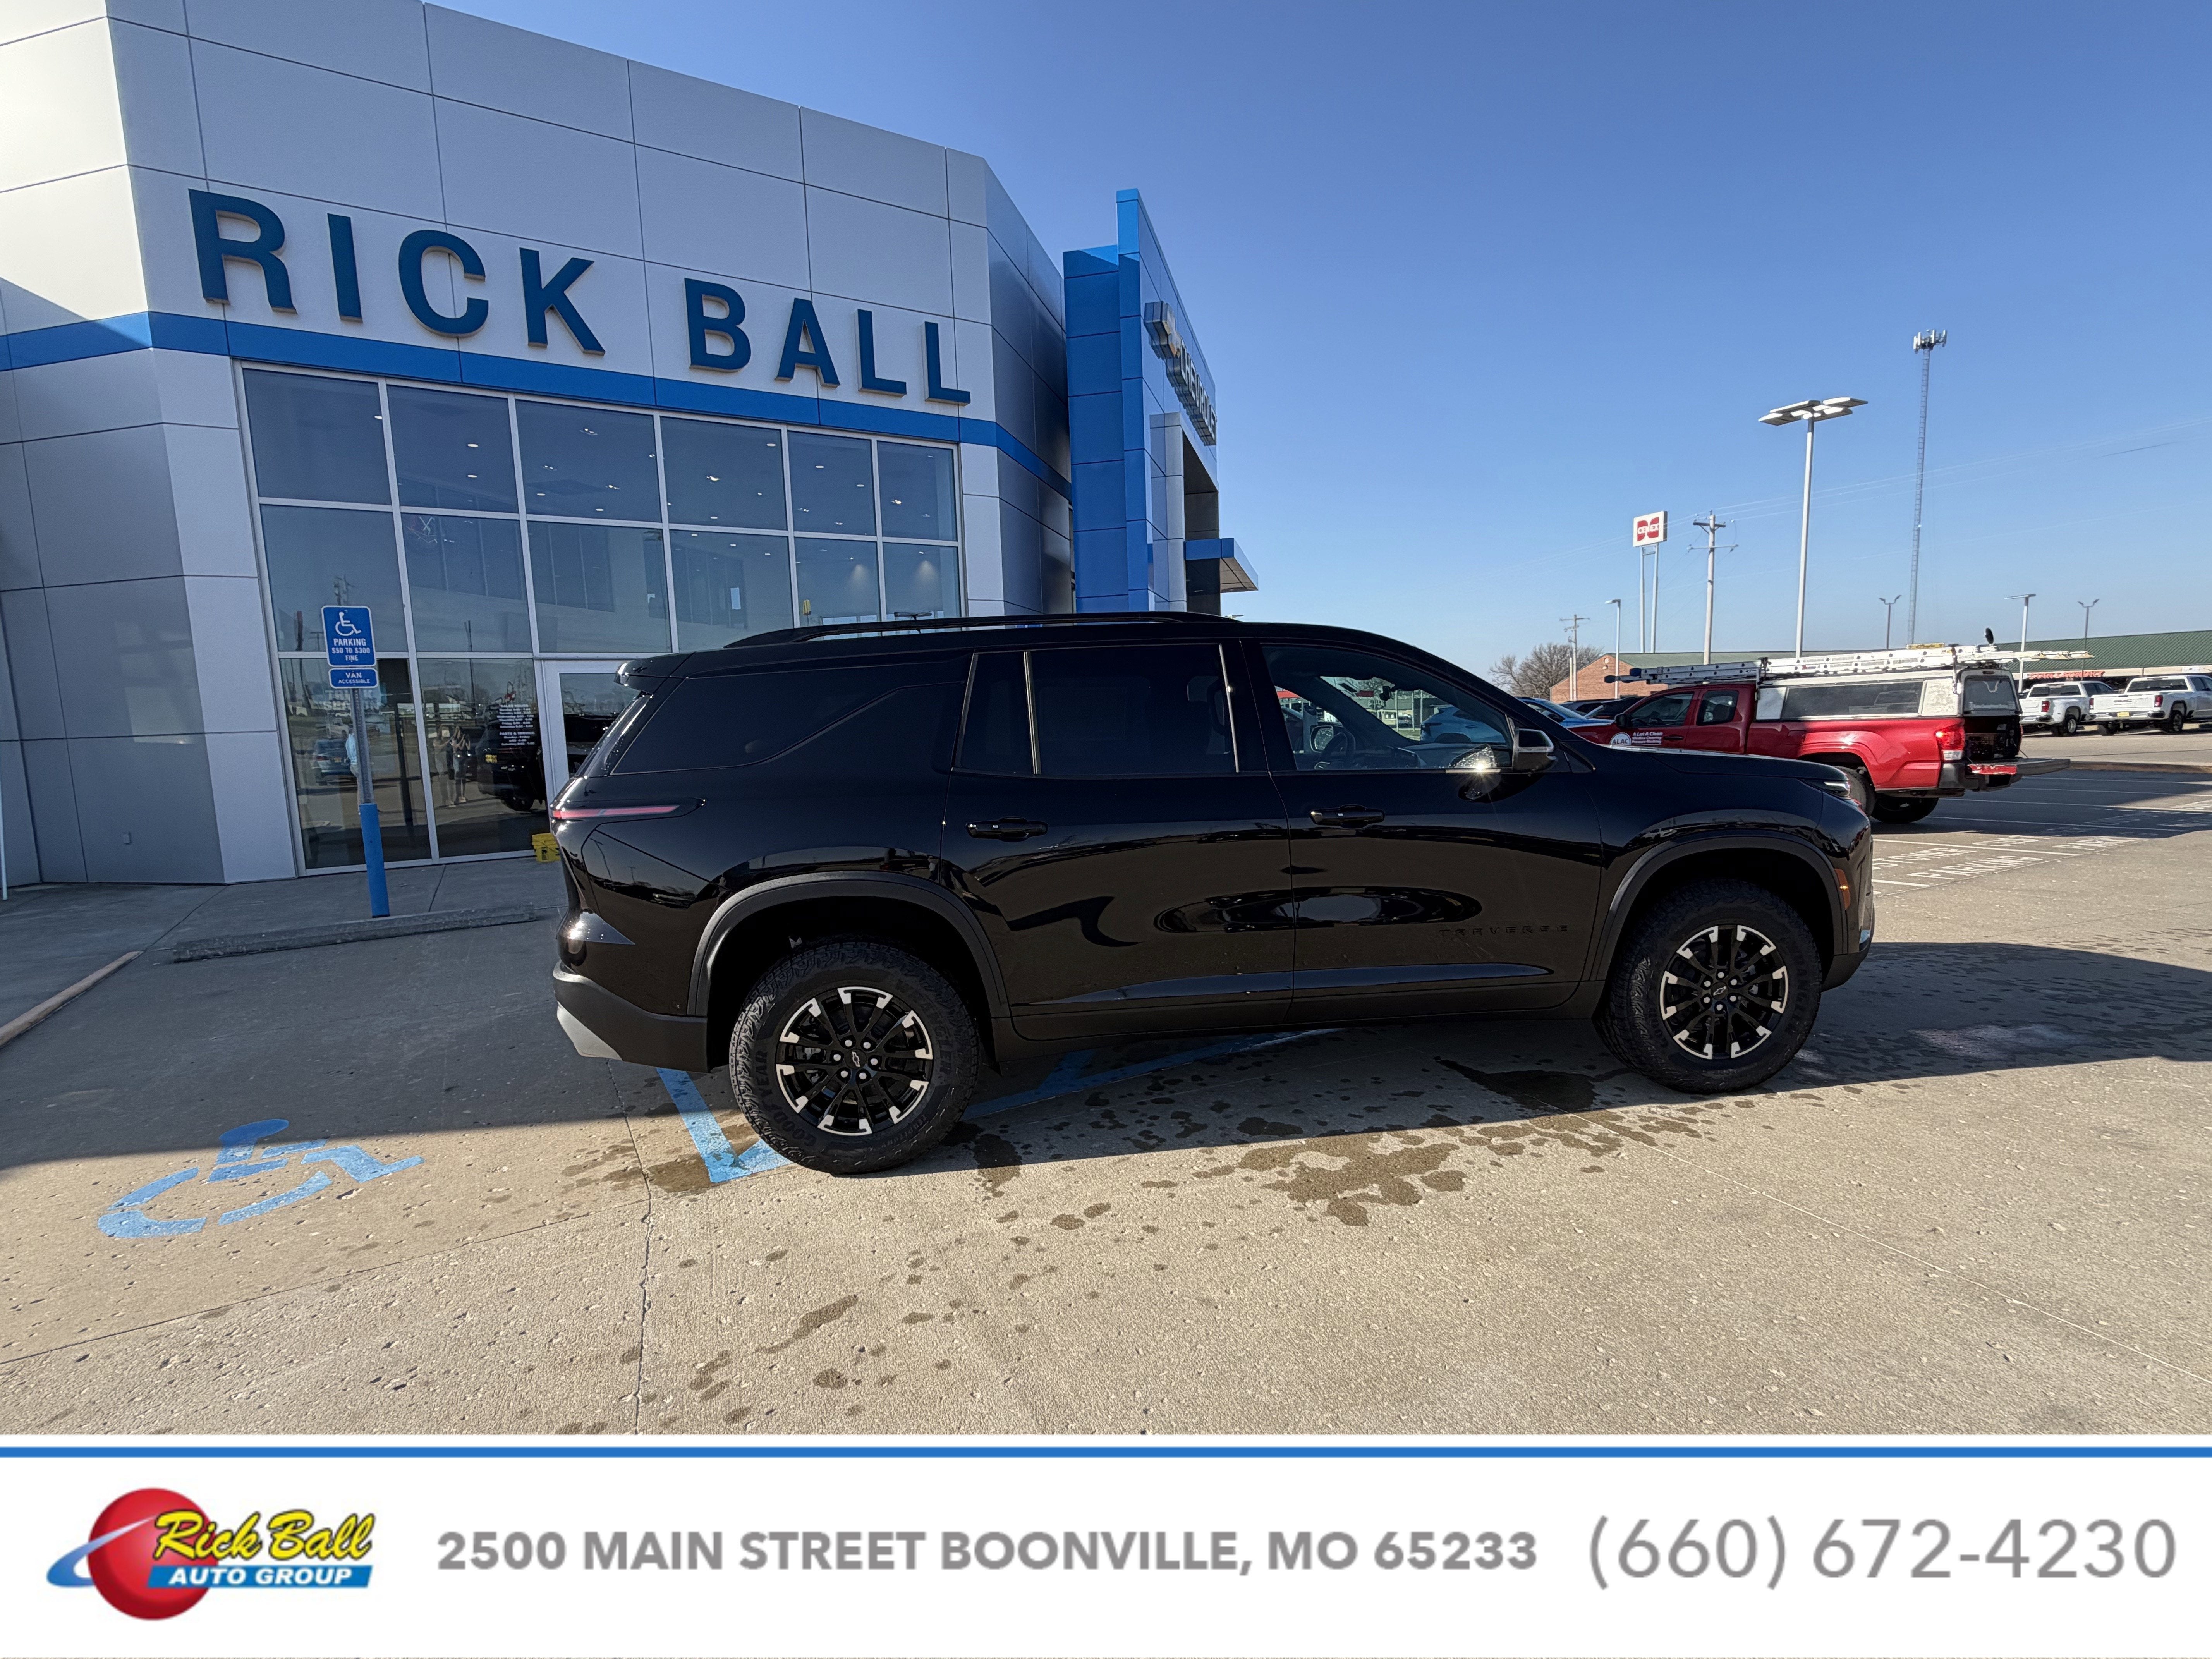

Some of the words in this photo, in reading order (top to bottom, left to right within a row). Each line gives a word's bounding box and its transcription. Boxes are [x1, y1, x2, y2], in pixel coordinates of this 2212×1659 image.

[188, 189, 606, 356] RICK
[685, 278, 970, 406] BALL
[1907, 855, 2044, 880] PARKING
[1439, 925, 1568, 937] TRAVERSE
